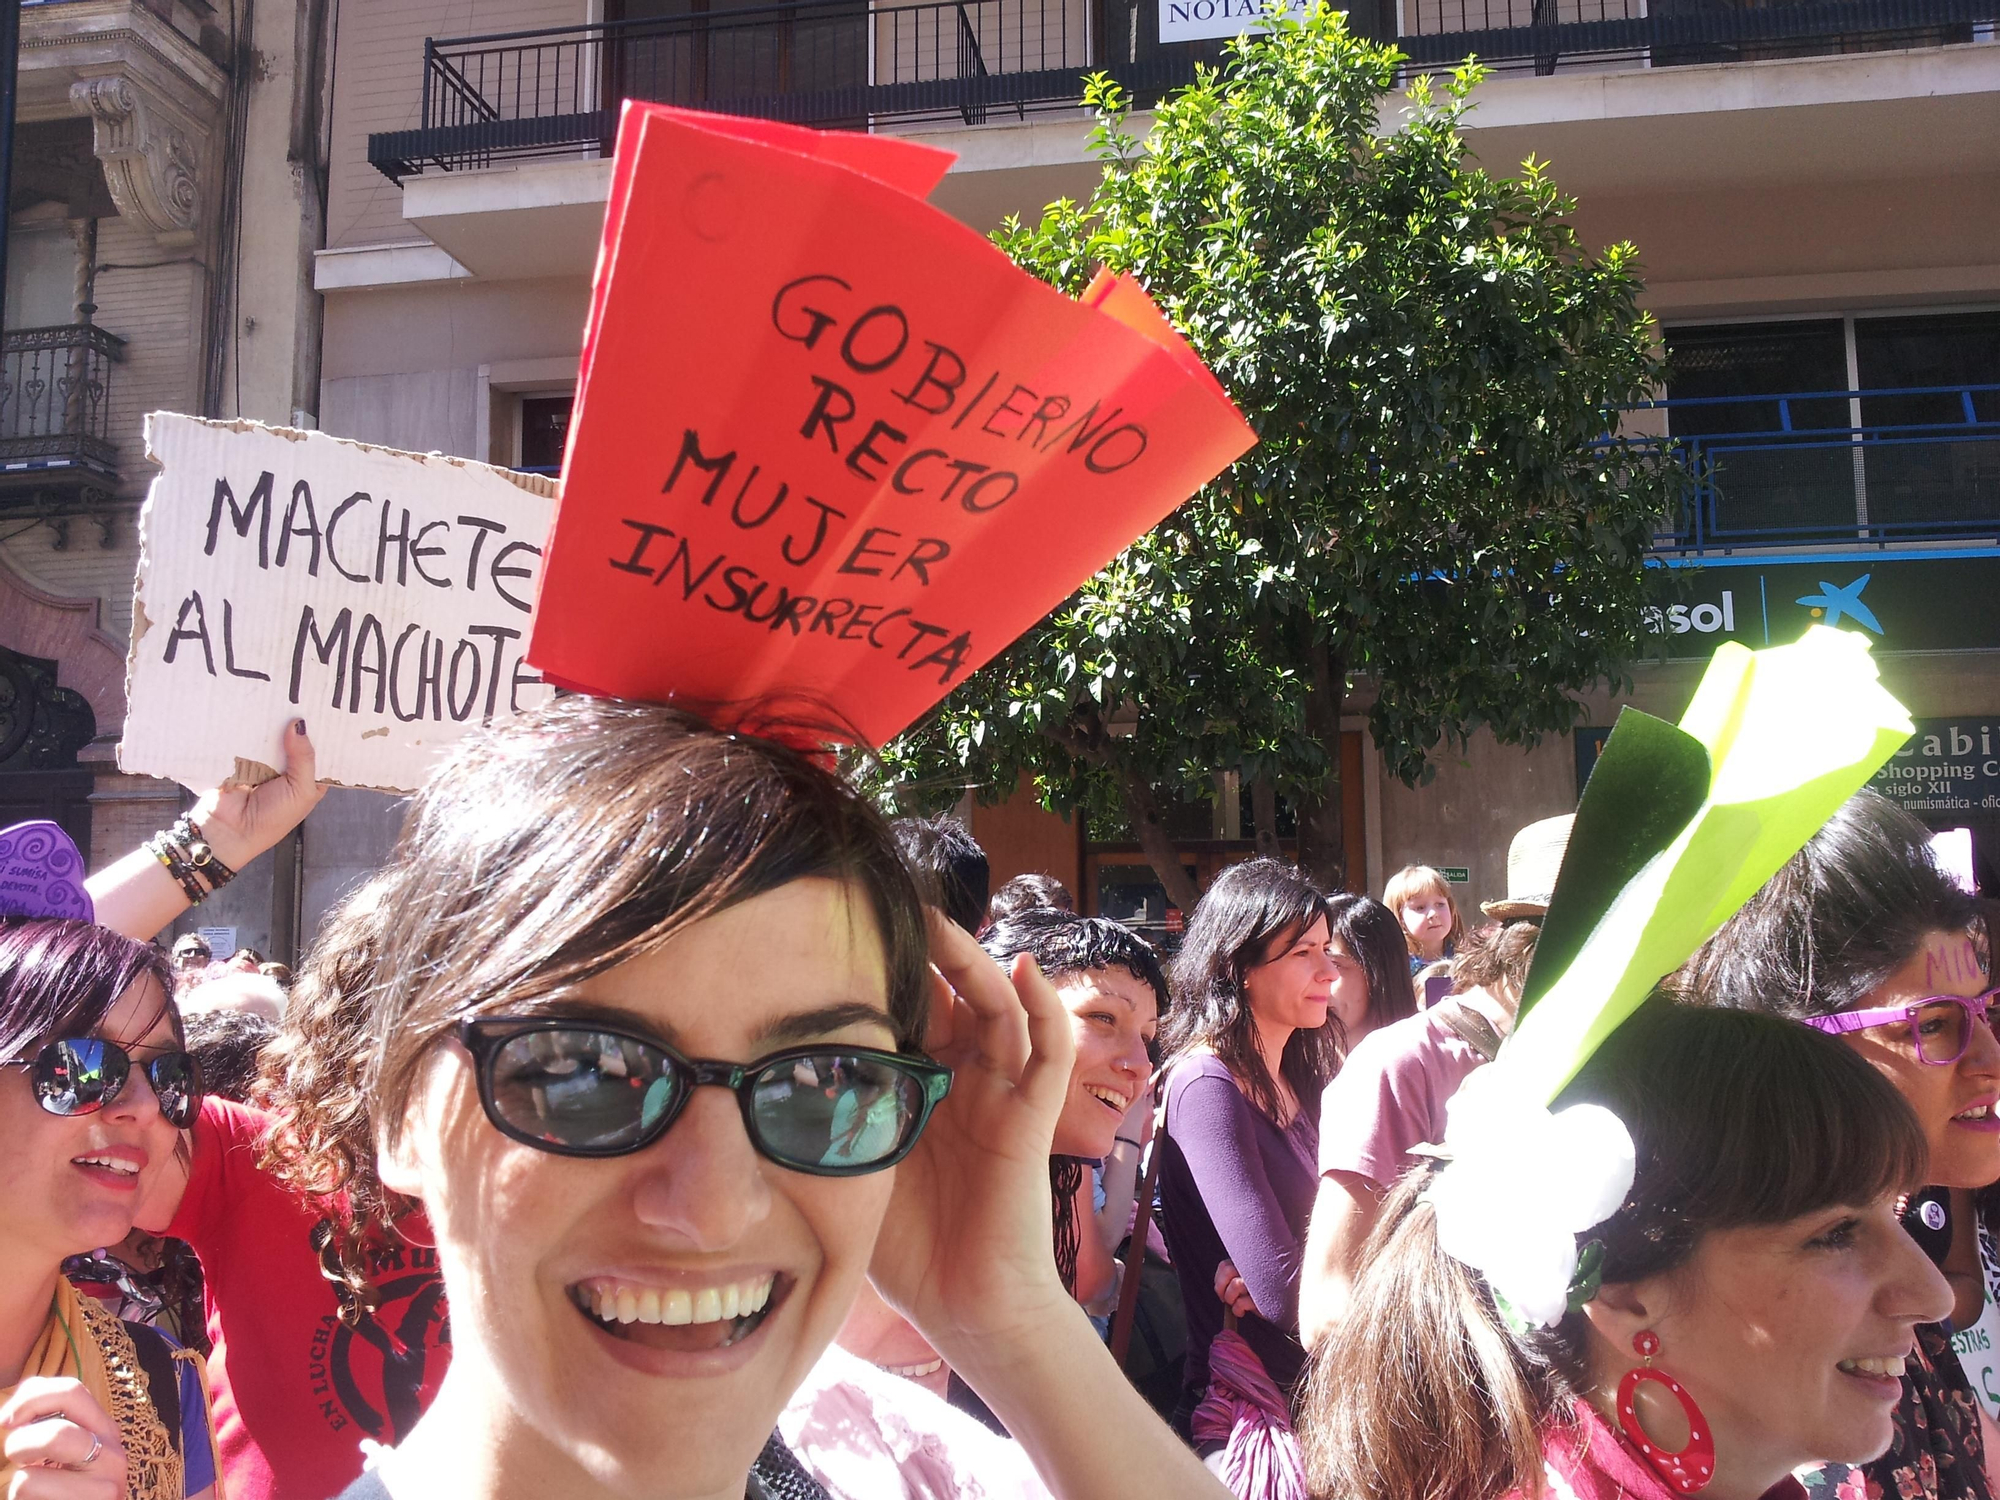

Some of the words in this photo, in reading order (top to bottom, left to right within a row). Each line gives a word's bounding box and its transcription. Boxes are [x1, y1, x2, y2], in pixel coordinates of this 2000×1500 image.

[1168, 0, 1309, 23] NOTAA
[771, 275, 1148, 474] GOBIERNO
[799, 374, 1020, 514] RECTO
[203, 470, 542, 614] MACHETE
[661, 428, 952, 587] MUJER
[608, 518, 973, 686] INSURRECTA
[163, 589, 271, 682] AL
[288, 604, 545, 728] MACHOTE
[1877, 761, 1976, 780] Shopping
[1894, 726, 2000, 757] abi
[1885, 782, 1922, 797] siglo
[1927, 781, 1951, 794] XII
[1903, 795, 1970, 810] numismática
[309, 1313, 338, 1396] LUCHA
[319, 1401, 348, 1432] EN
